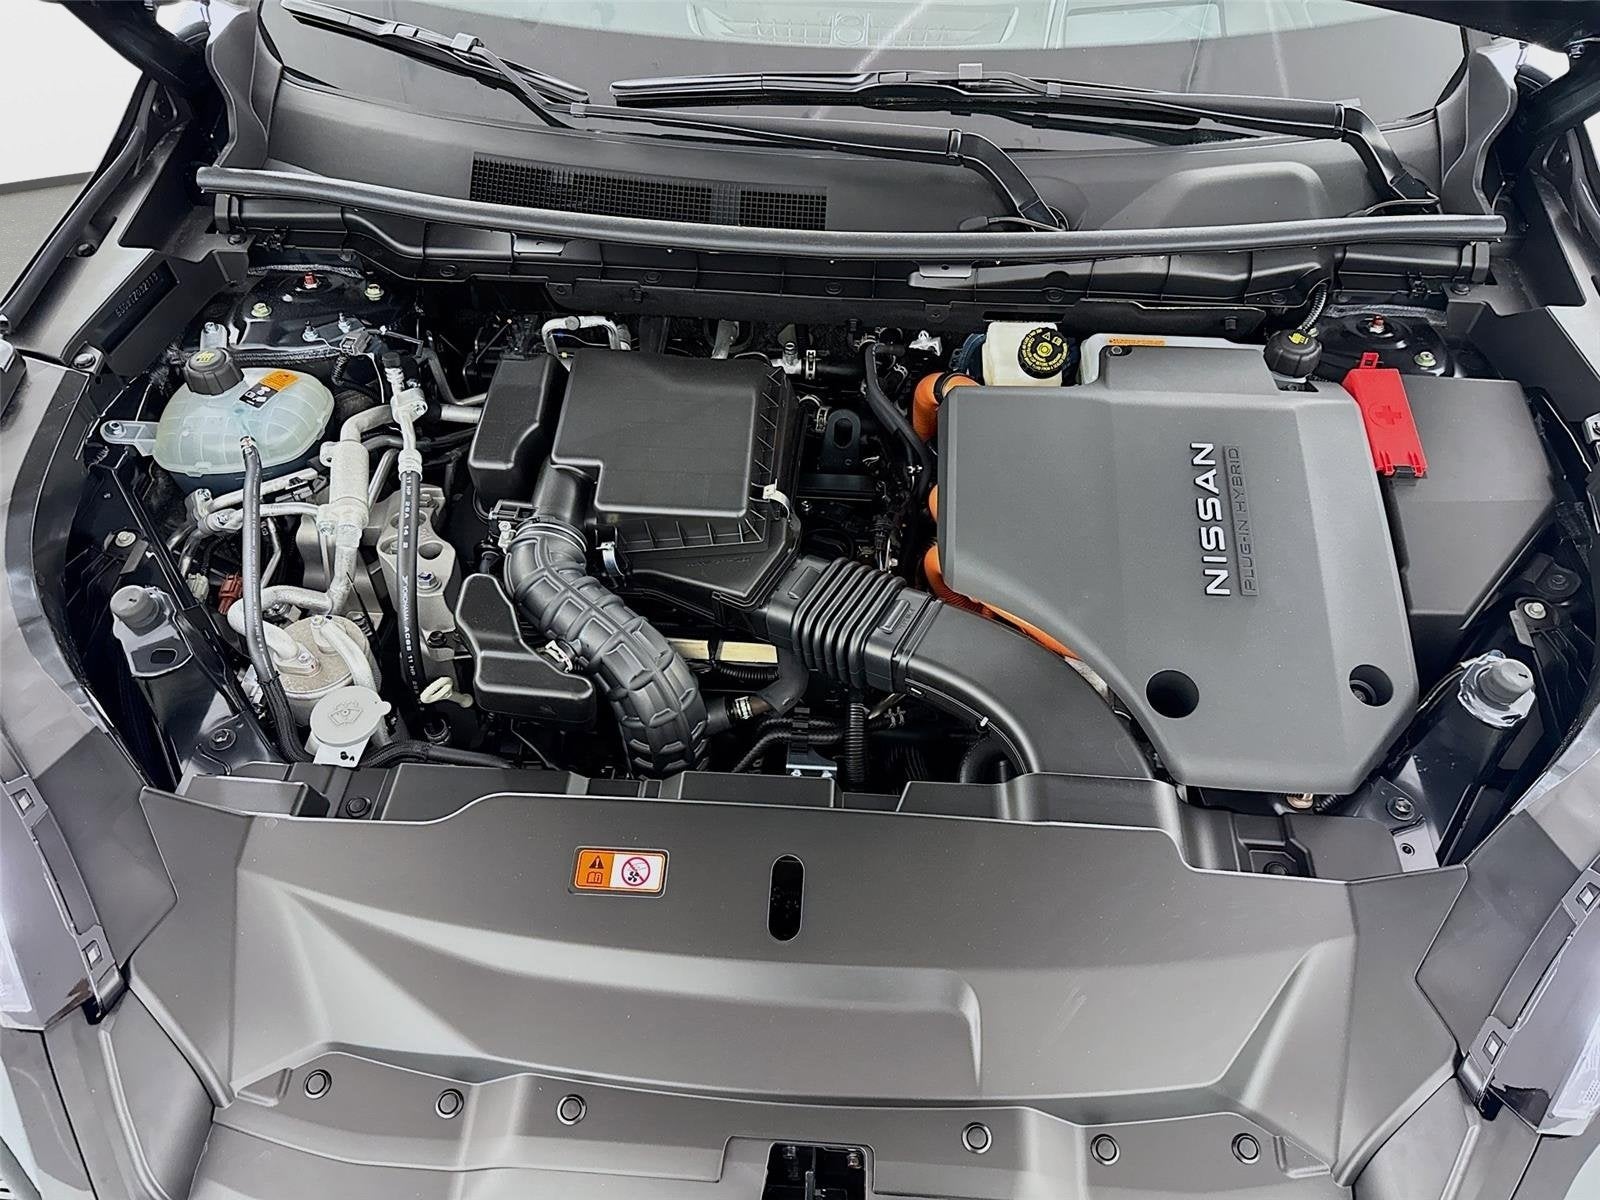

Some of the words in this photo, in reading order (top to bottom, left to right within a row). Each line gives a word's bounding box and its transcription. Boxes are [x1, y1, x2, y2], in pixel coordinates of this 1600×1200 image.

[1229, 448, 1246, 512] HYBRID
[1190, 442, 1231, 595] NISSAN
[1238, 520, 1255, 591] PLUG-IN
